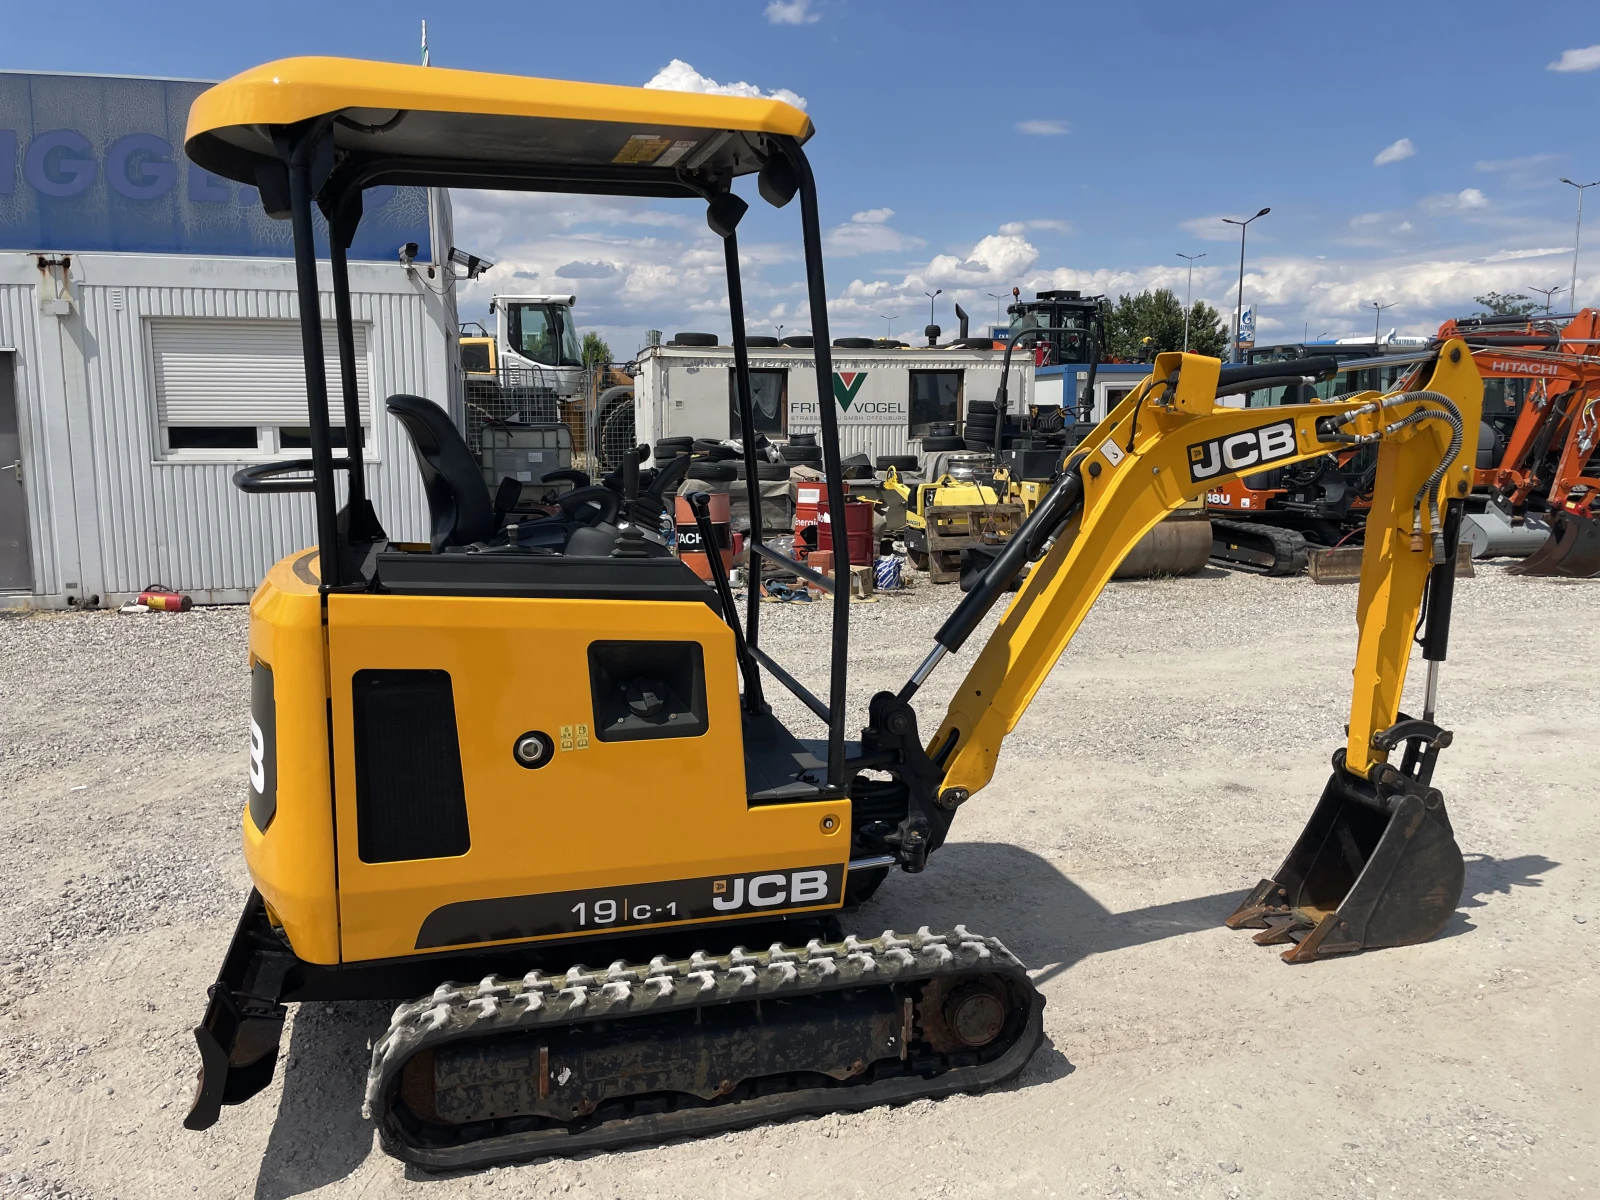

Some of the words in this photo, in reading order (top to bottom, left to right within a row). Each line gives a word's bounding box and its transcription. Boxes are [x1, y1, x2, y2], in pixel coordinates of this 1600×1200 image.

[1492, 361, 1558, 375] HITACHI
[791, 403, 836, 413] FRI
[854, 403, 906, 413] VOGEL
[1193, 423, 1295, 478] JCB
[712, 870, 828, 911] JCB
